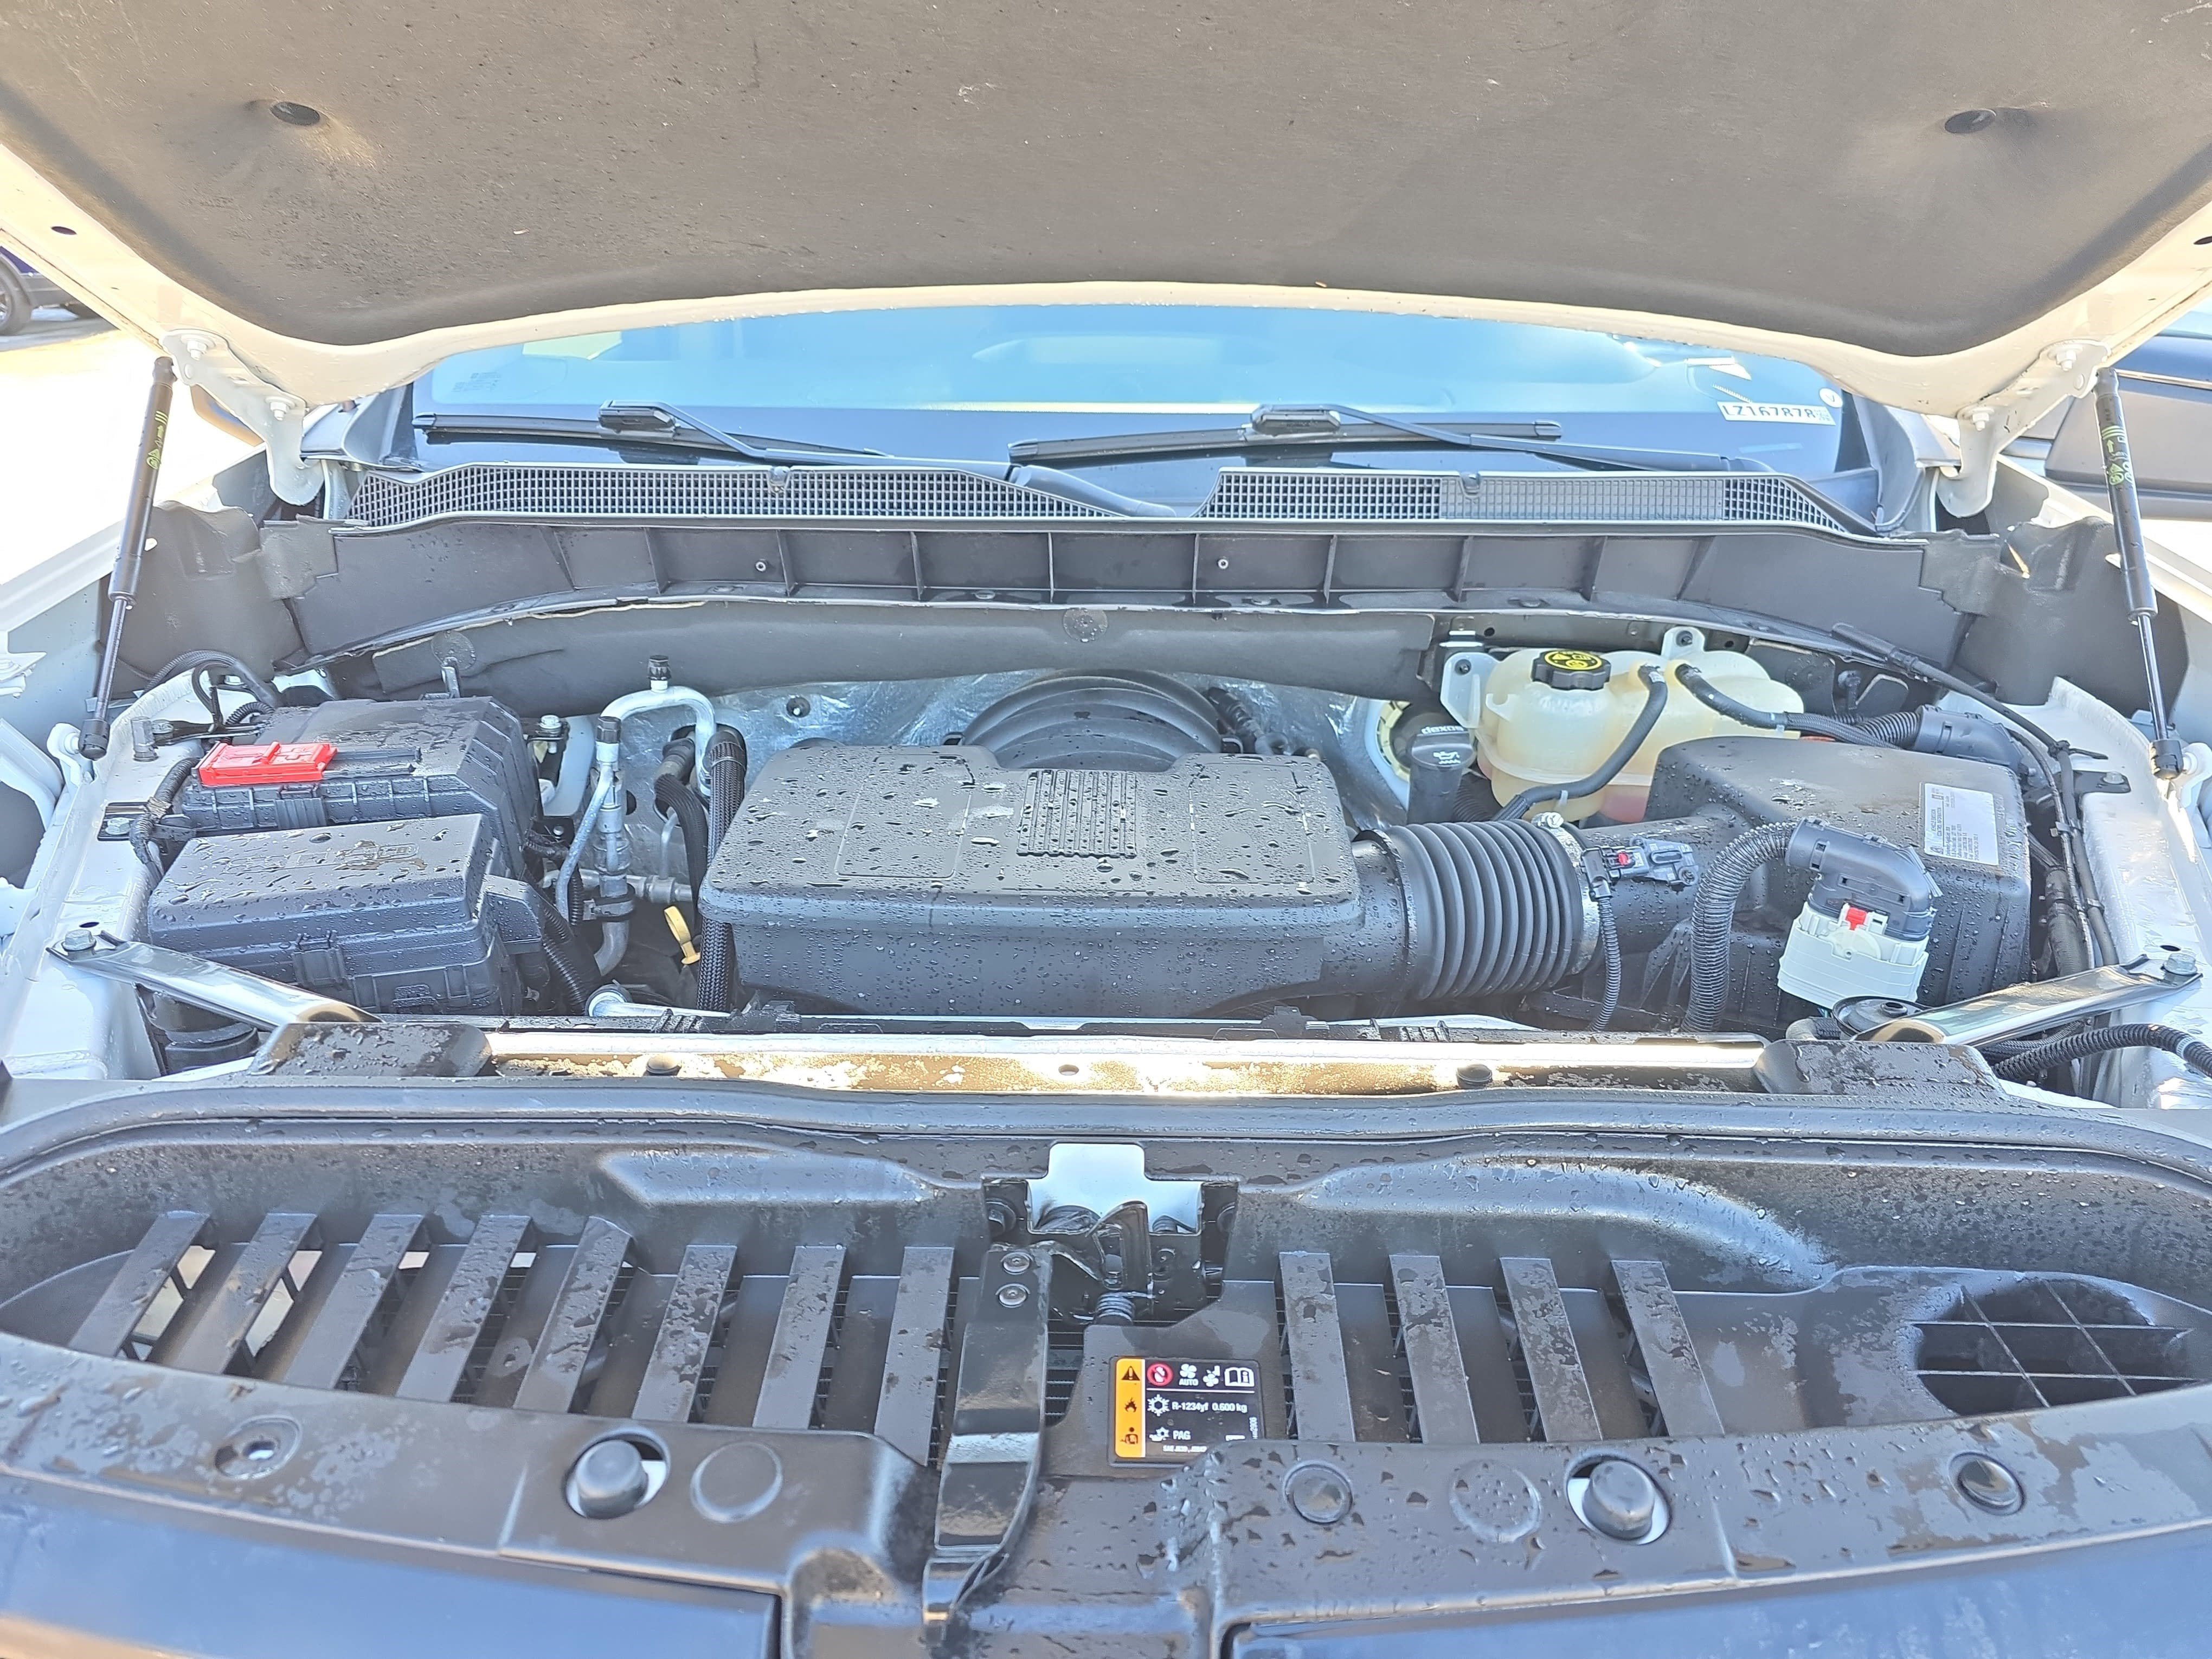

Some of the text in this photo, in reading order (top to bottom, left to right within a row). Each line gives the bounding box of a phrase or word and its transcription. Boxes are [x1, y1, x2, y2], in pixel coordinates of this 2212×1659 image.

[1421, 725, 1464, 734] dexos
[1212, 1403, 1236, 1411] 0.600
[1236, 1403, 1248, 1413] kg
[1173, 1430, 1191, 1440] PAG
